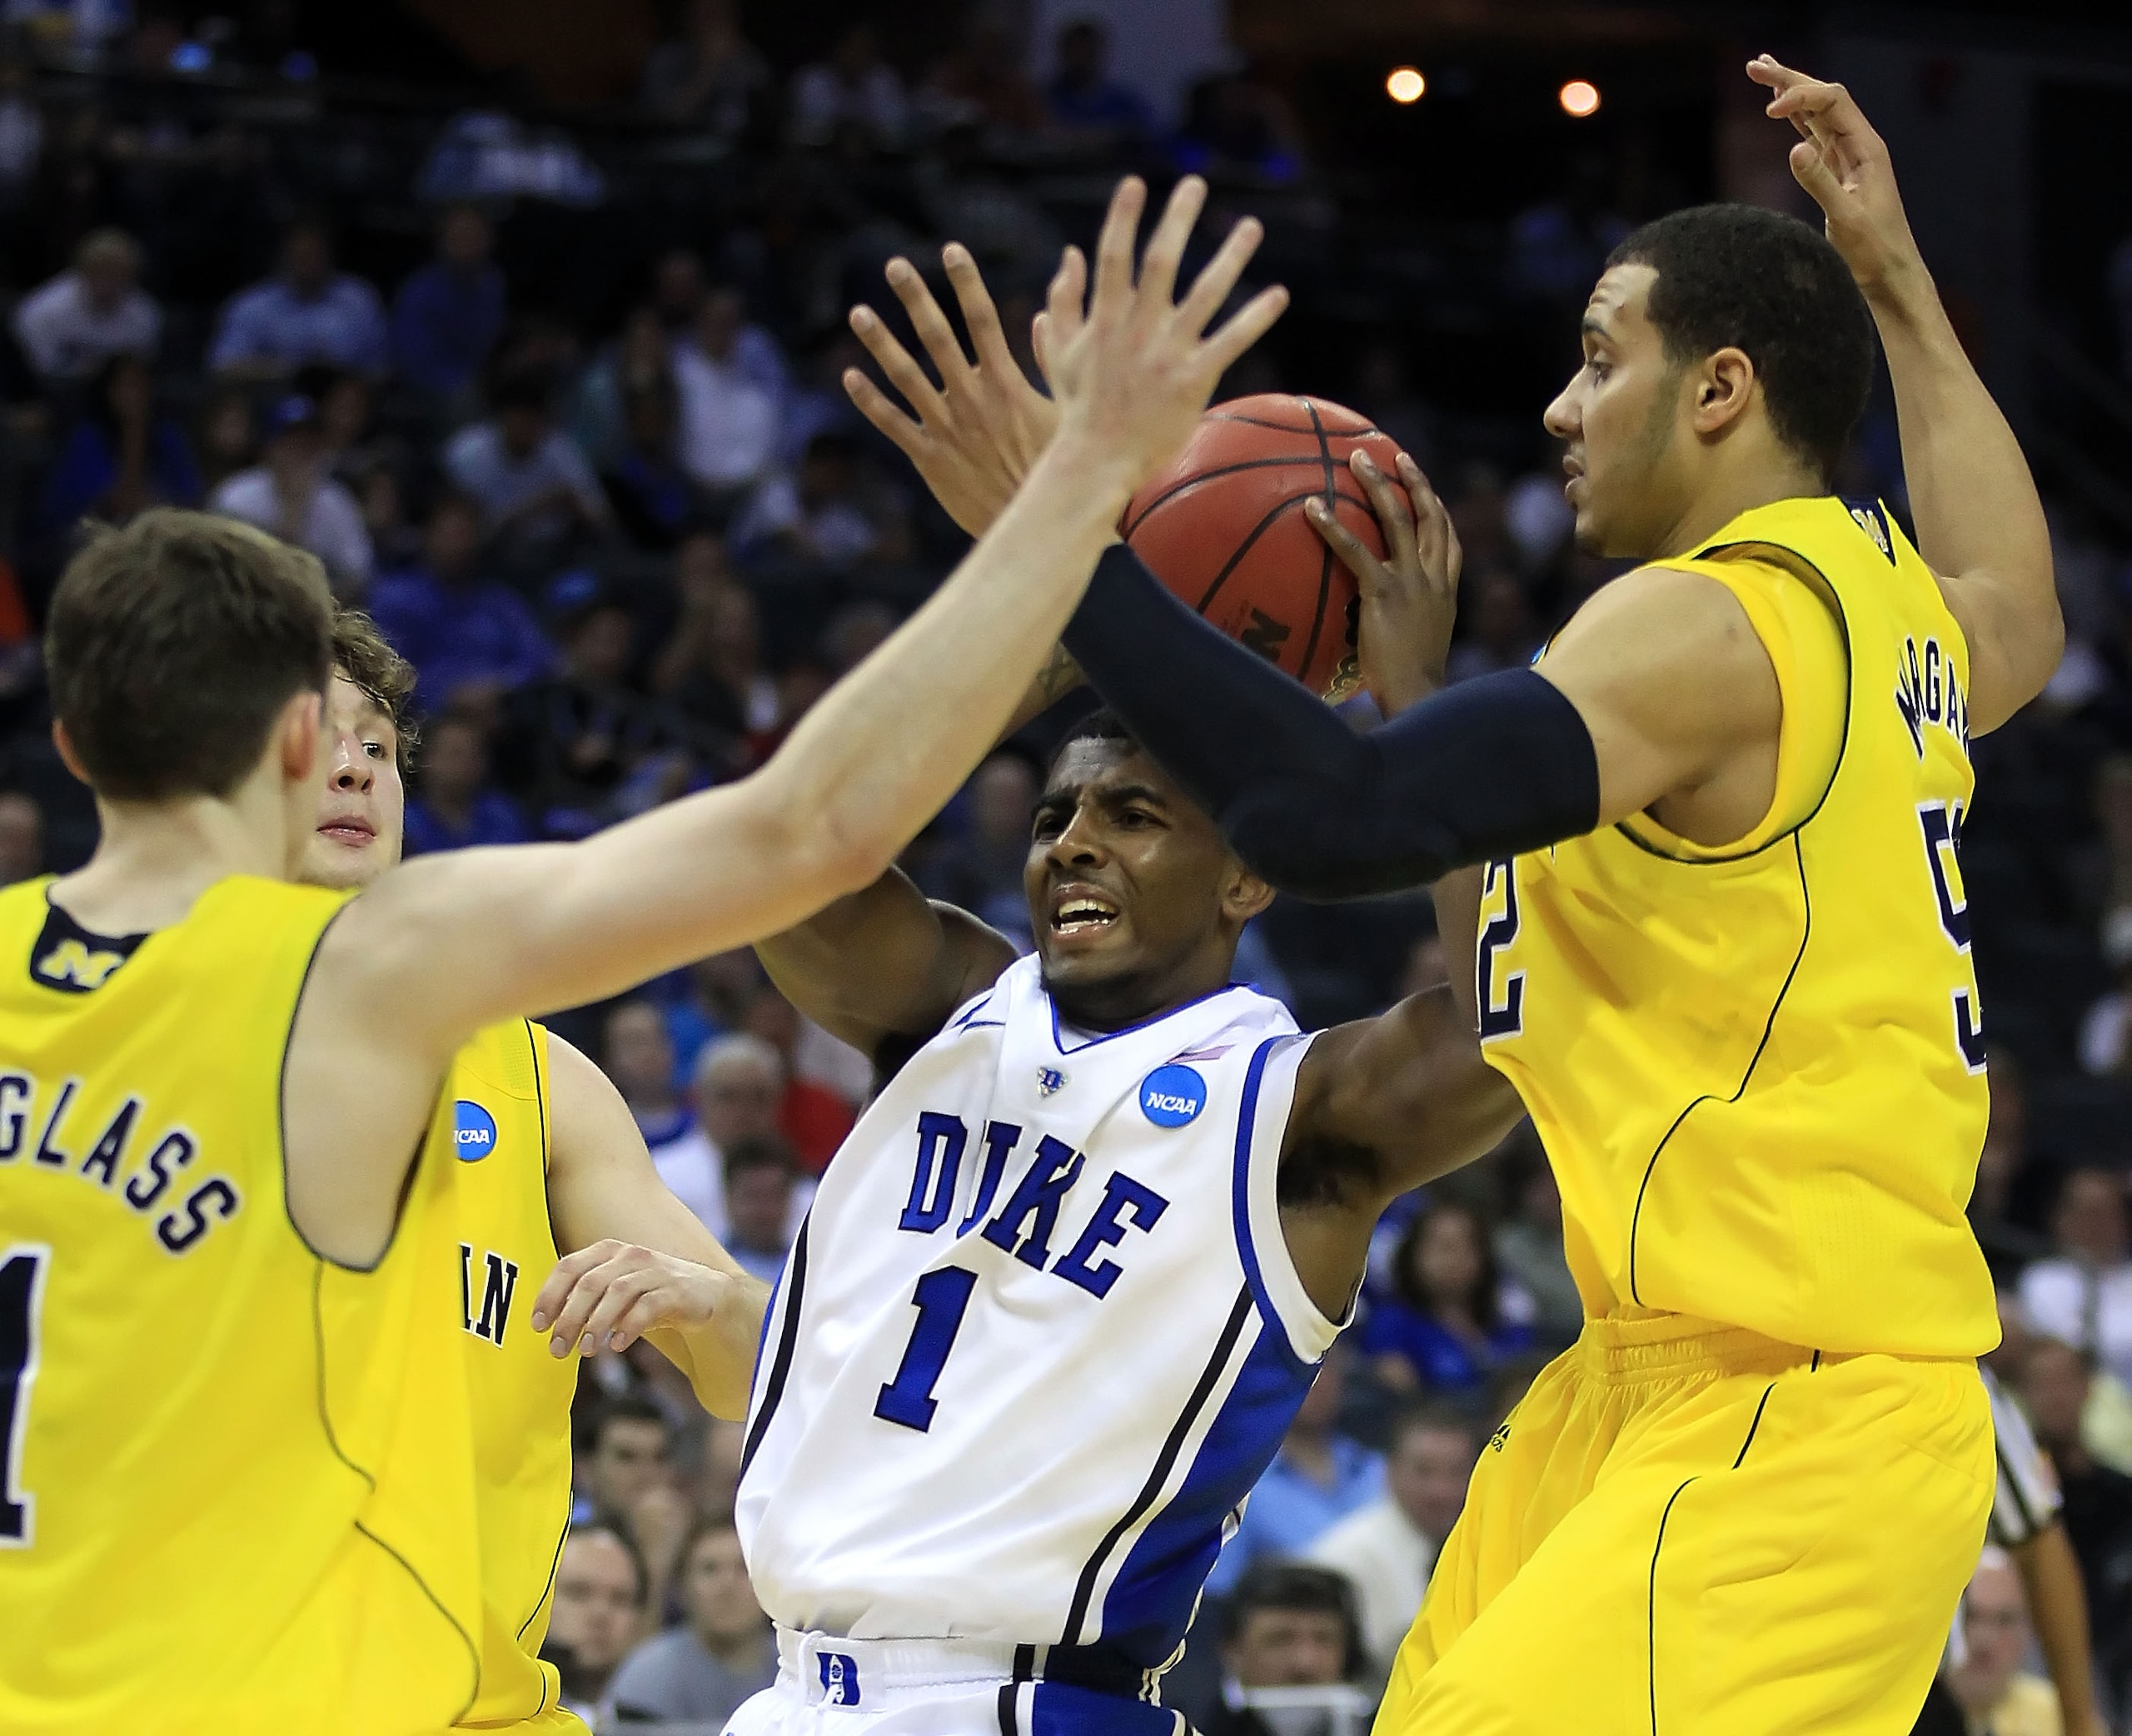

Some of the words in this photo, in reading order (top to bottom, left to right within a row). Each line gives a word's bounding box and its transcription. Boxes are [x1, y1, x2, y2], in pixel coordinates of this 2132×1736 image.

[0, 1074, 239, 1252] GLASS
[454, 1129, 490, 1145] CAA
[1146, 1092, 1197, 1116] NCAA
[898, 1111, 1169, 1300] DUKE
[874, 1266, 979, 1432] 1
